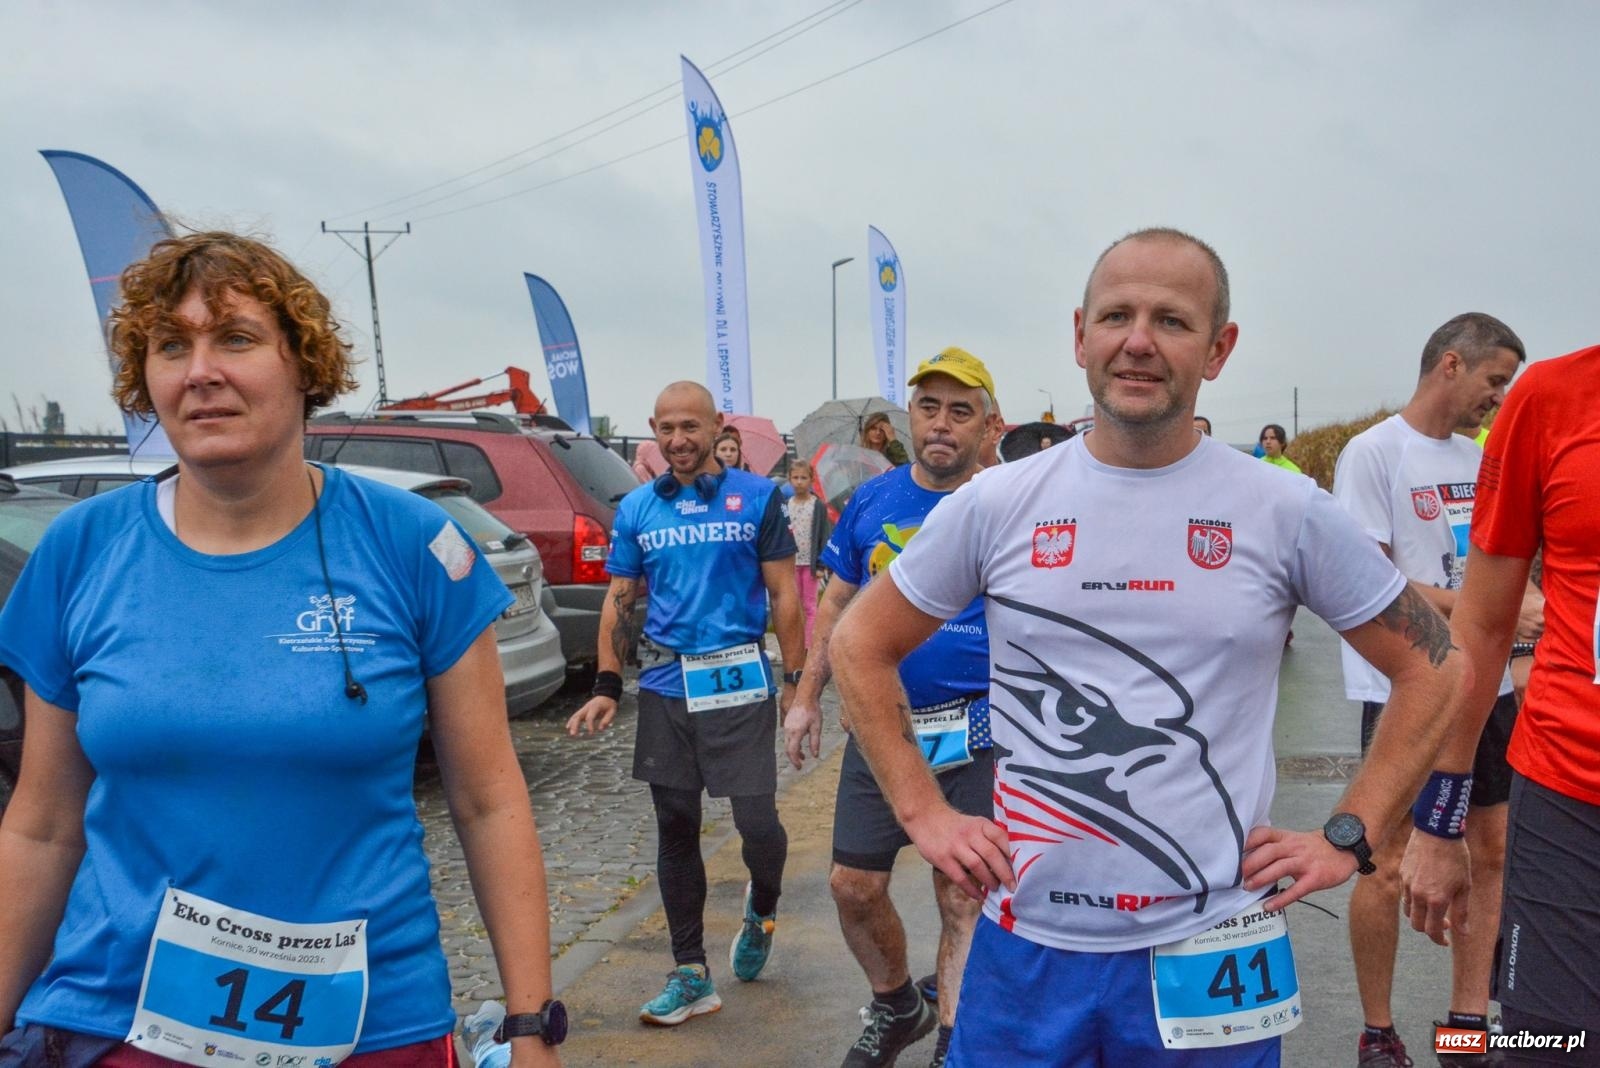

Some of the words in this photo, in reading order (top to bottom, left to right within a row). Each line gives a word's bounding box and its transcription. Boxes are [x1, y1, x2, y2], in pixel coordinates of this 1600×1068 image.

[706, 181, 722, 267] STOWARZYSZENIE
[716, 319, 728, 338] DLA
[722, 398, 733, 414] JUT
[1440, 486, 1450, 499] X
[1036, 518, 1077, 528] POLSKA
[1188, 518, 1232, 528] RACIBÓRZ
[637, 521, 756, 553] RUNNERS
[296, 606, 355, 637] Gryf
[938, 624, 982, 635] MARATON
[710, 667, 744, 693] 13
[923, 715, 947, 725] przez
[922, 736, 942, 763] 7
[173, 902, 211, 926] Eko
[216, 917, 273, 944] Cross
[277, 935, 332, 950] przez
[335, 932, 357, 948] Las
[1207, 917, 1238, 930] oss
[211, 936, 244, 952] Kornice,
[247, 945, 258, 954] 30
[259, 949, 297, 963] września
[298, 955, 320, 964] 2023
[1194, 936, 1222, 945] Kornice,
[1222, 933, 1232, 942] 30
[1508, 923, 1520, 991] SALOMON
[1207, 947, 1279, 1008] 41
[209, 967, 306, 1041] 14
